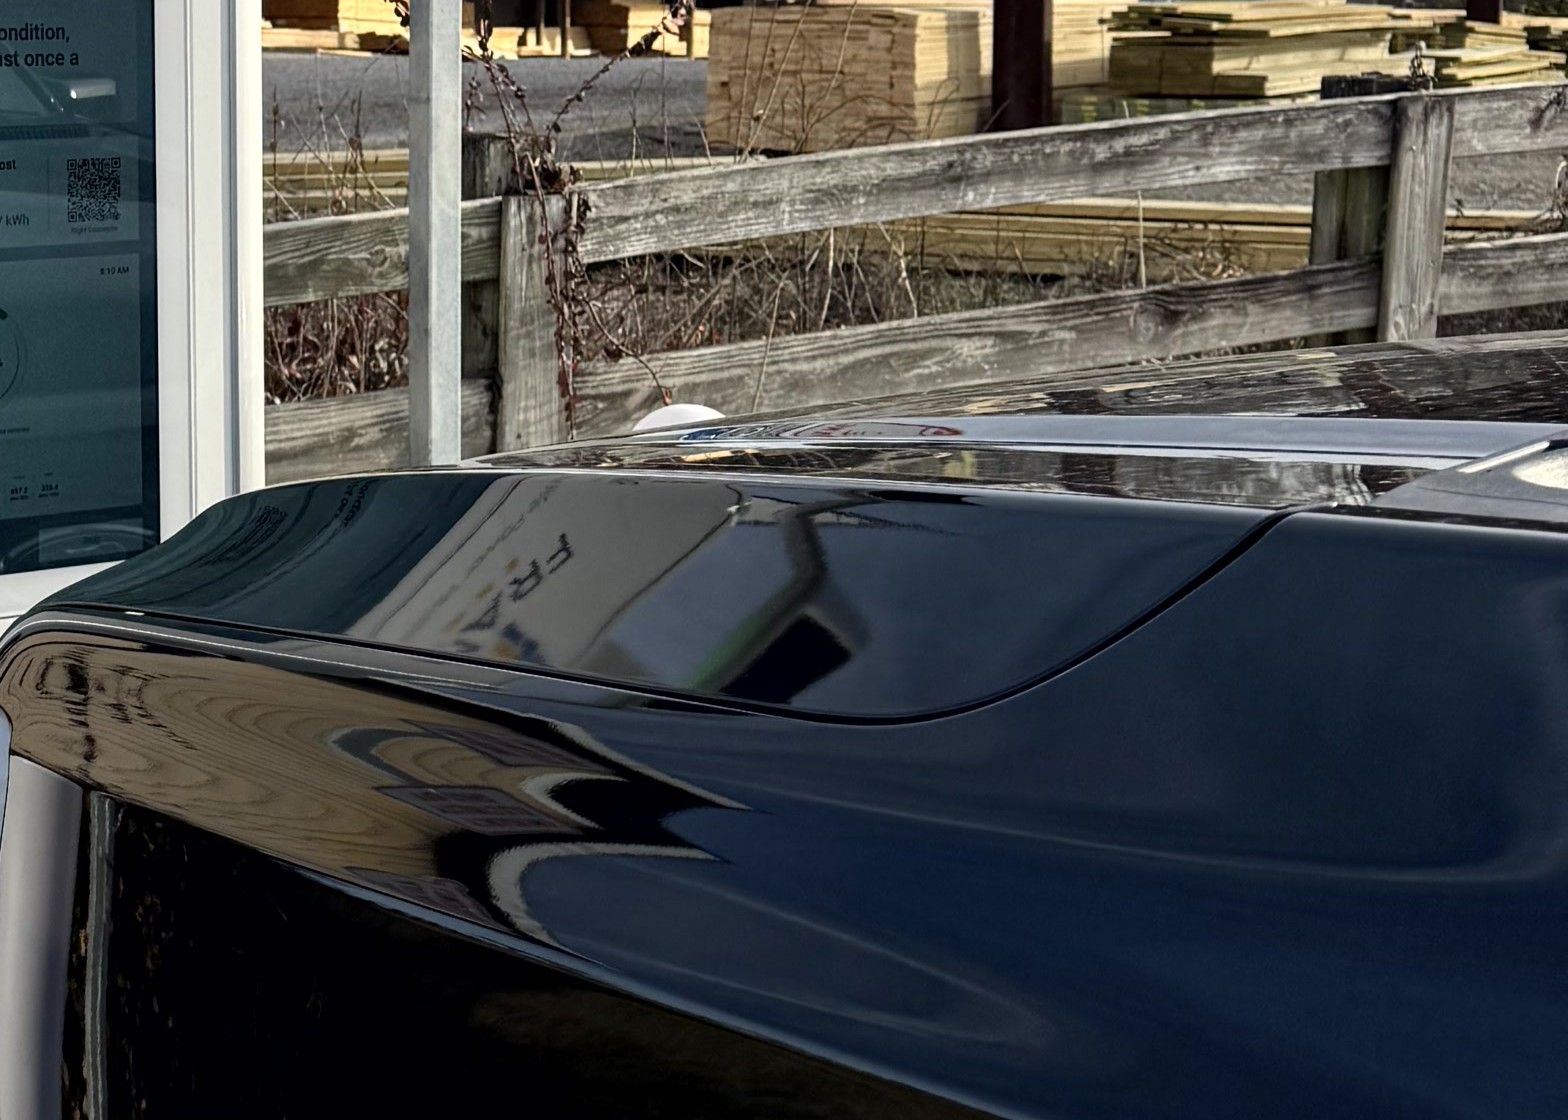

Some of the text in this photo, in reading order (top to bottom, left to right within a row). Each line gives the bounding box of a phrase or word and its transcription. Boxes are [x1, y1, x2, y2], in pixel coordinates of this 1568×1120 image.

[24, 53, 64, 67] once
[69, 54, 79, 67] a
[6, 214, 30, 228] kWh
[117, 266, 130, 275] AM
